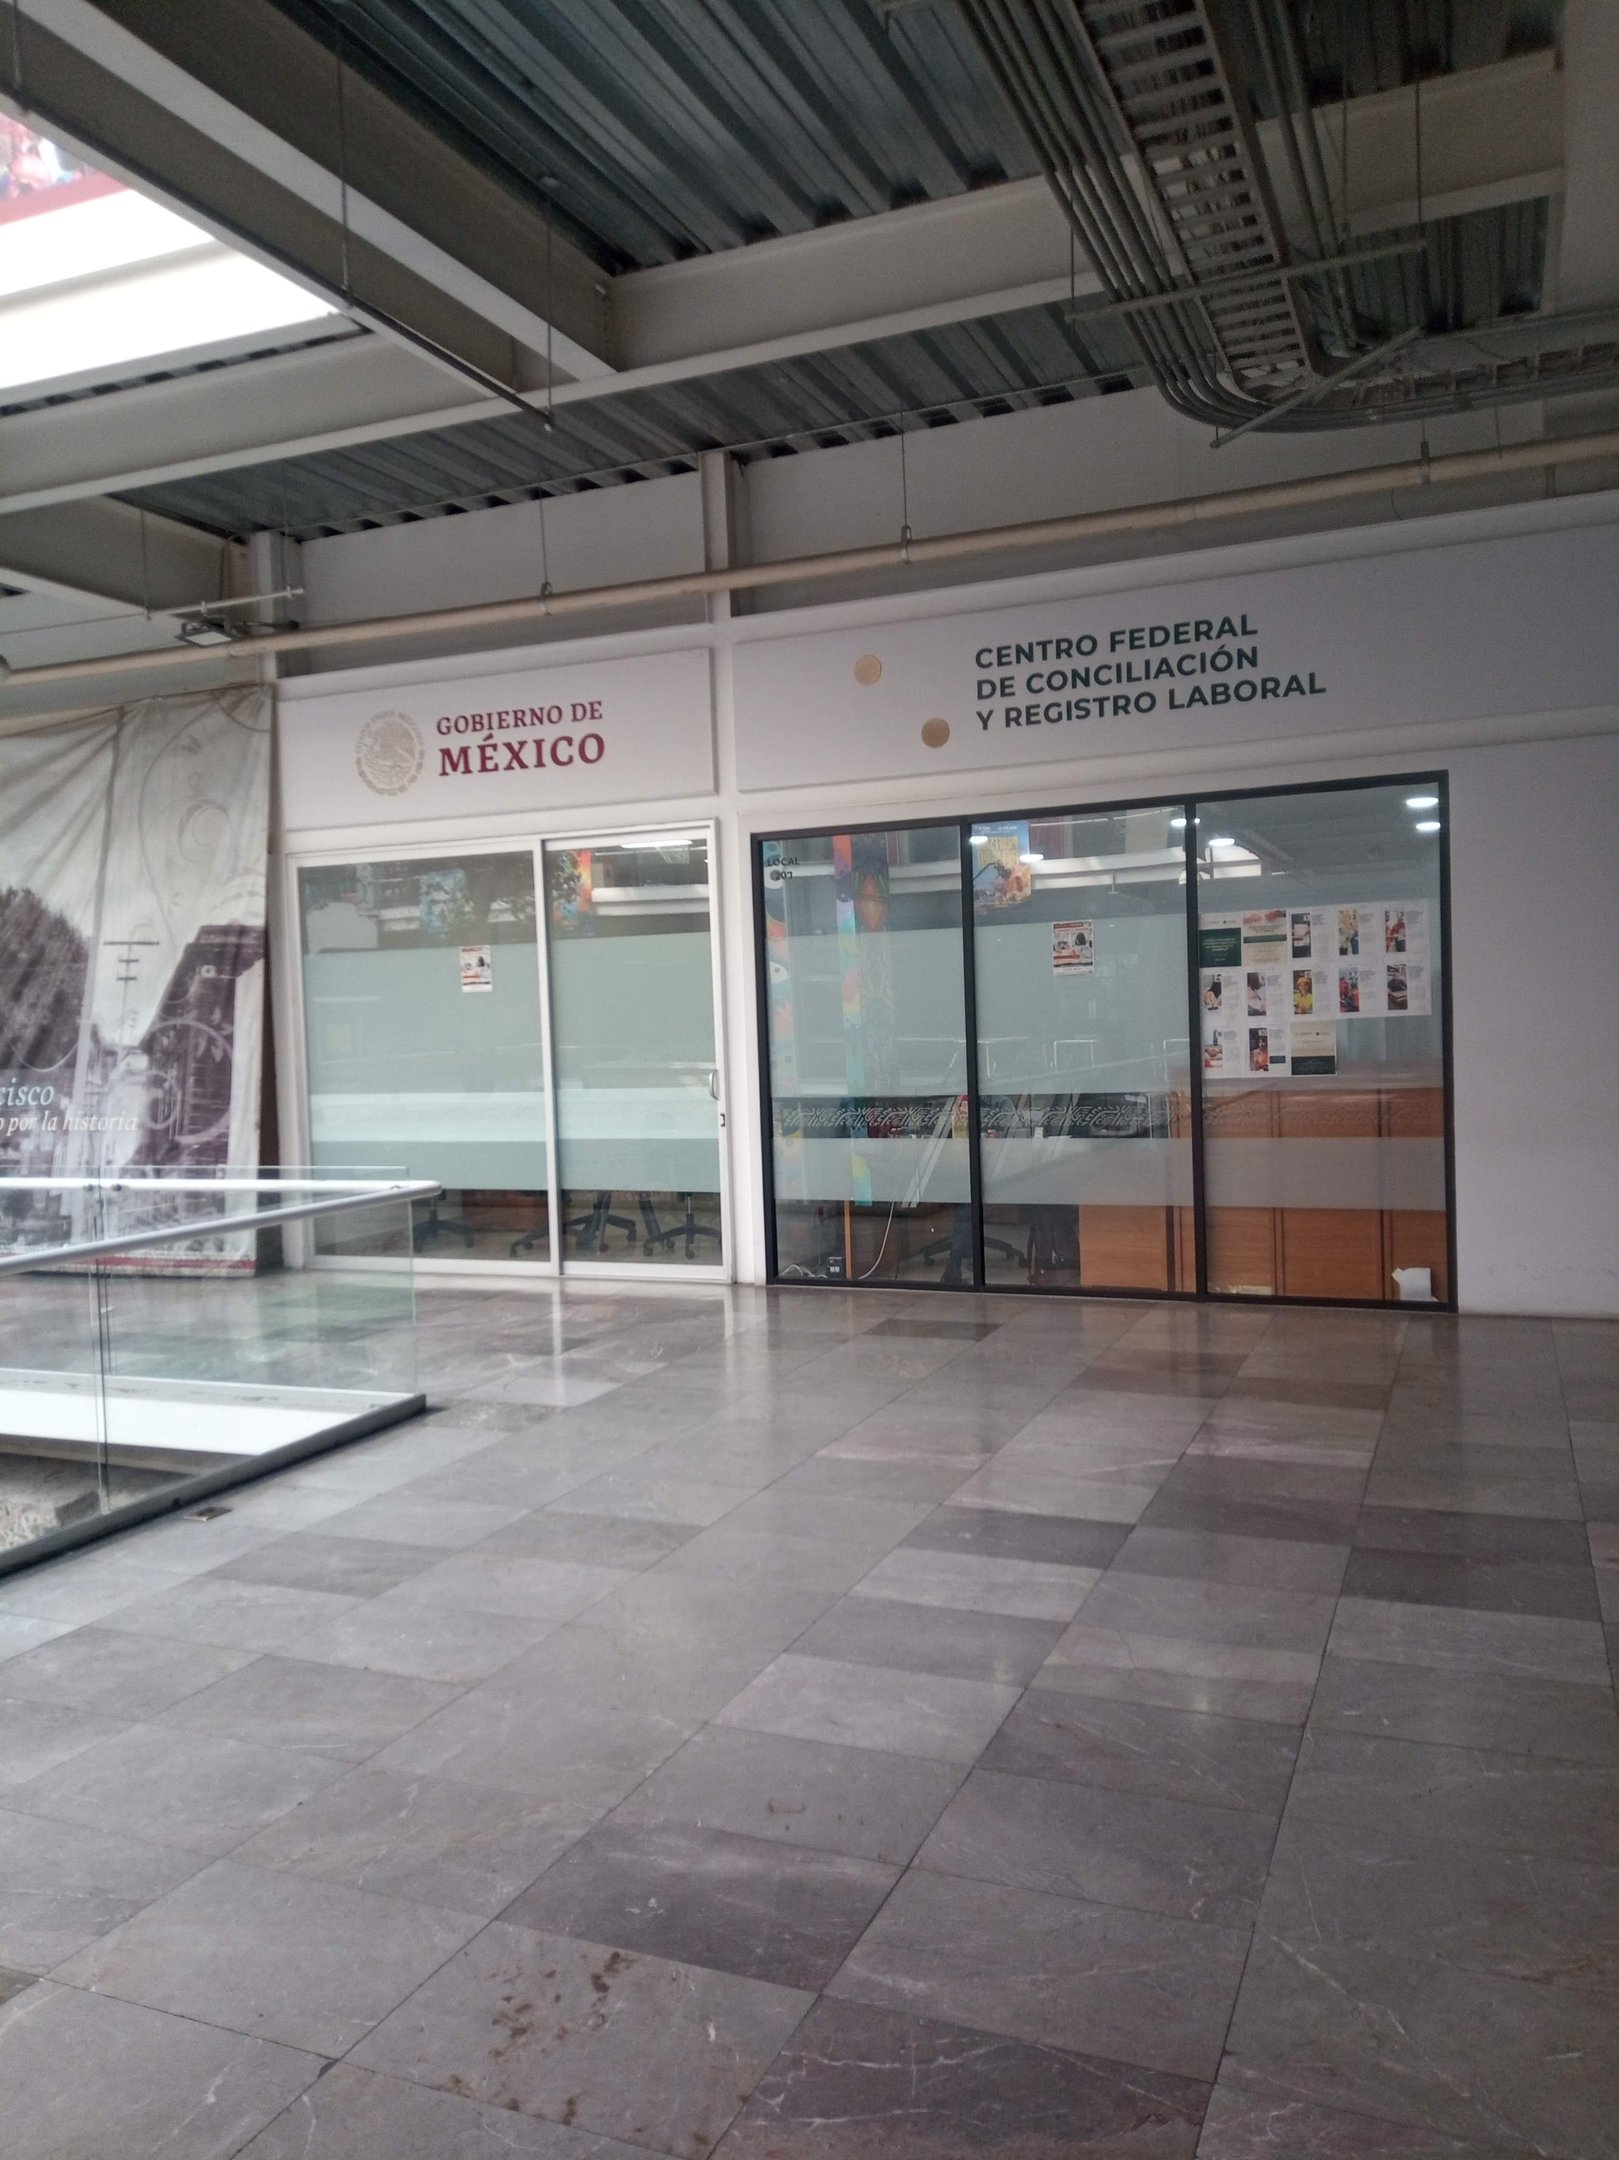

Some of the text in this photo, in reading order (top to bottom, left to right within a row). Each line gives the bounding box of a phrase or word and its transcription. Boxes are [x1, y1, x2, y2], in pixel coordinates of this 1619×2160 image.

[975, 613, 1258, 669] CENTRO FEDERAL
[977, 643, 1258, 700] DE CONCILIACIÓN
[436, 700, 603, 735] GOBIERNO DE
[976, 672, 1327, 731] Y REGISTRO LABORAL
[438, 732, 605, 776] MÉXICO
[767, 857, 800, 866] LOCAL
[6, 1116, 37, 1136] por
[42, 1110, 58, 1131] la
[63, 1110, 138, 1131] historia
